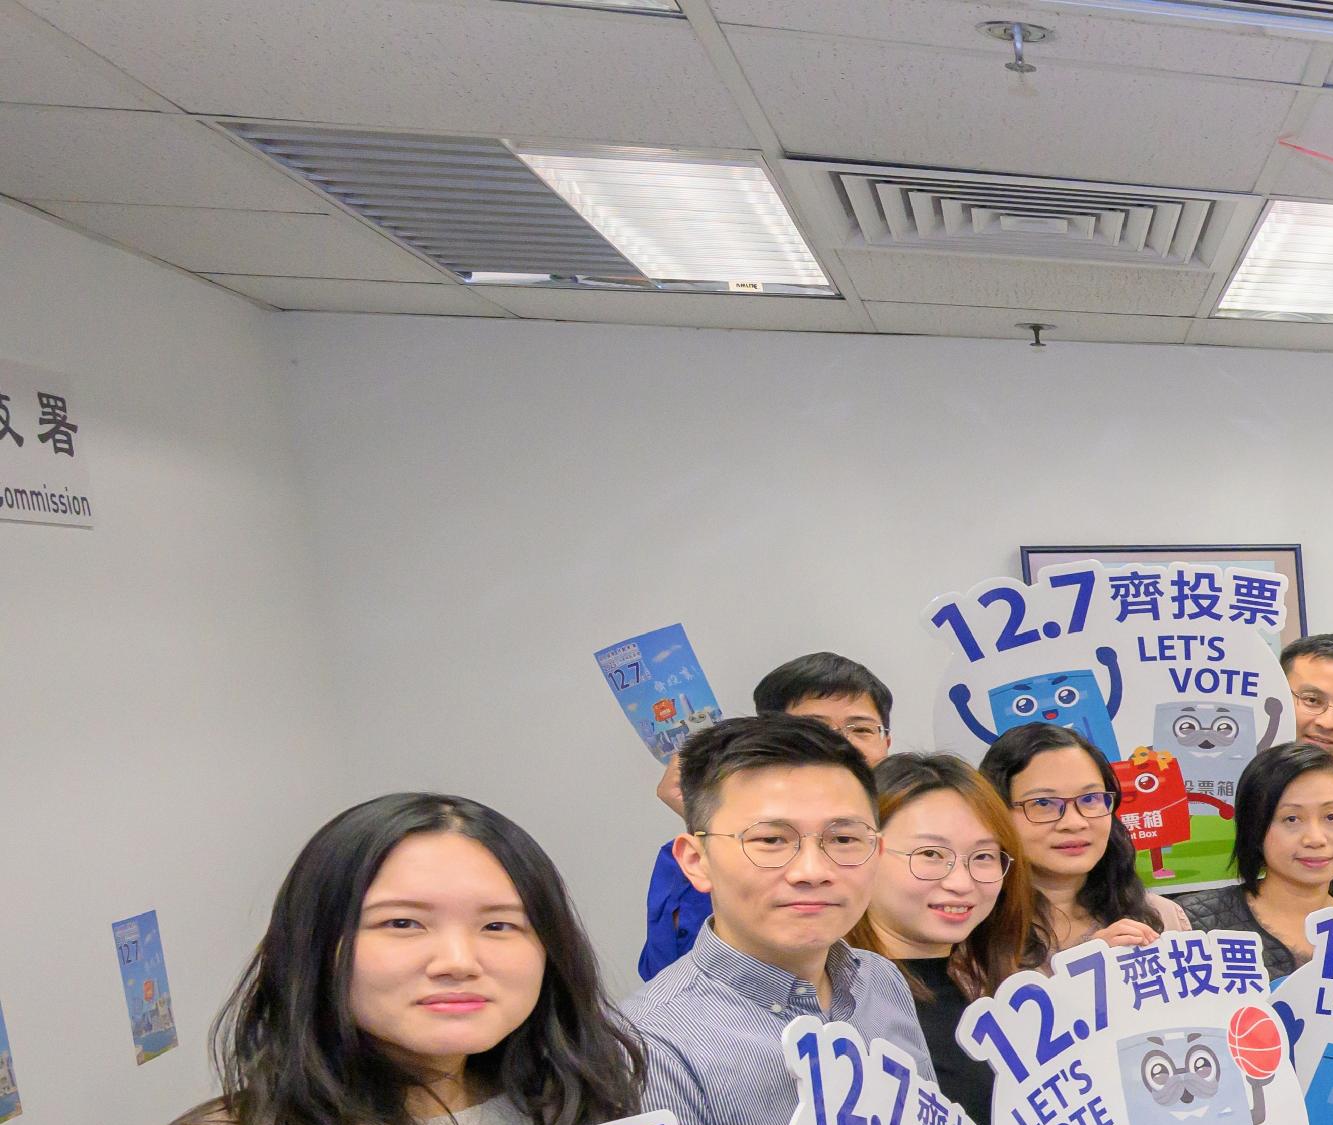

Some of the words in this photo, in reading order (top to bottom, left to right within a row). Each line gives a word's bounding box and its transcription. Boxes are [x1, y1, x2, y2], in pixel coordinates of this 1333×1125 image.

[0, 484, 91, 516] ommission
[931, 571, 1096, 663] 12.7
[1108, 570, 1281, 627] 齊投票
[1137, 635, 1225, 662] LET'S
[1168, 667, 1259, 697] VOTE
[1139, 830, 1157, 840] Box
[971, 953, 1109, 1084] 12.7
[1116, 938, 1264, 1011] 齊投票
